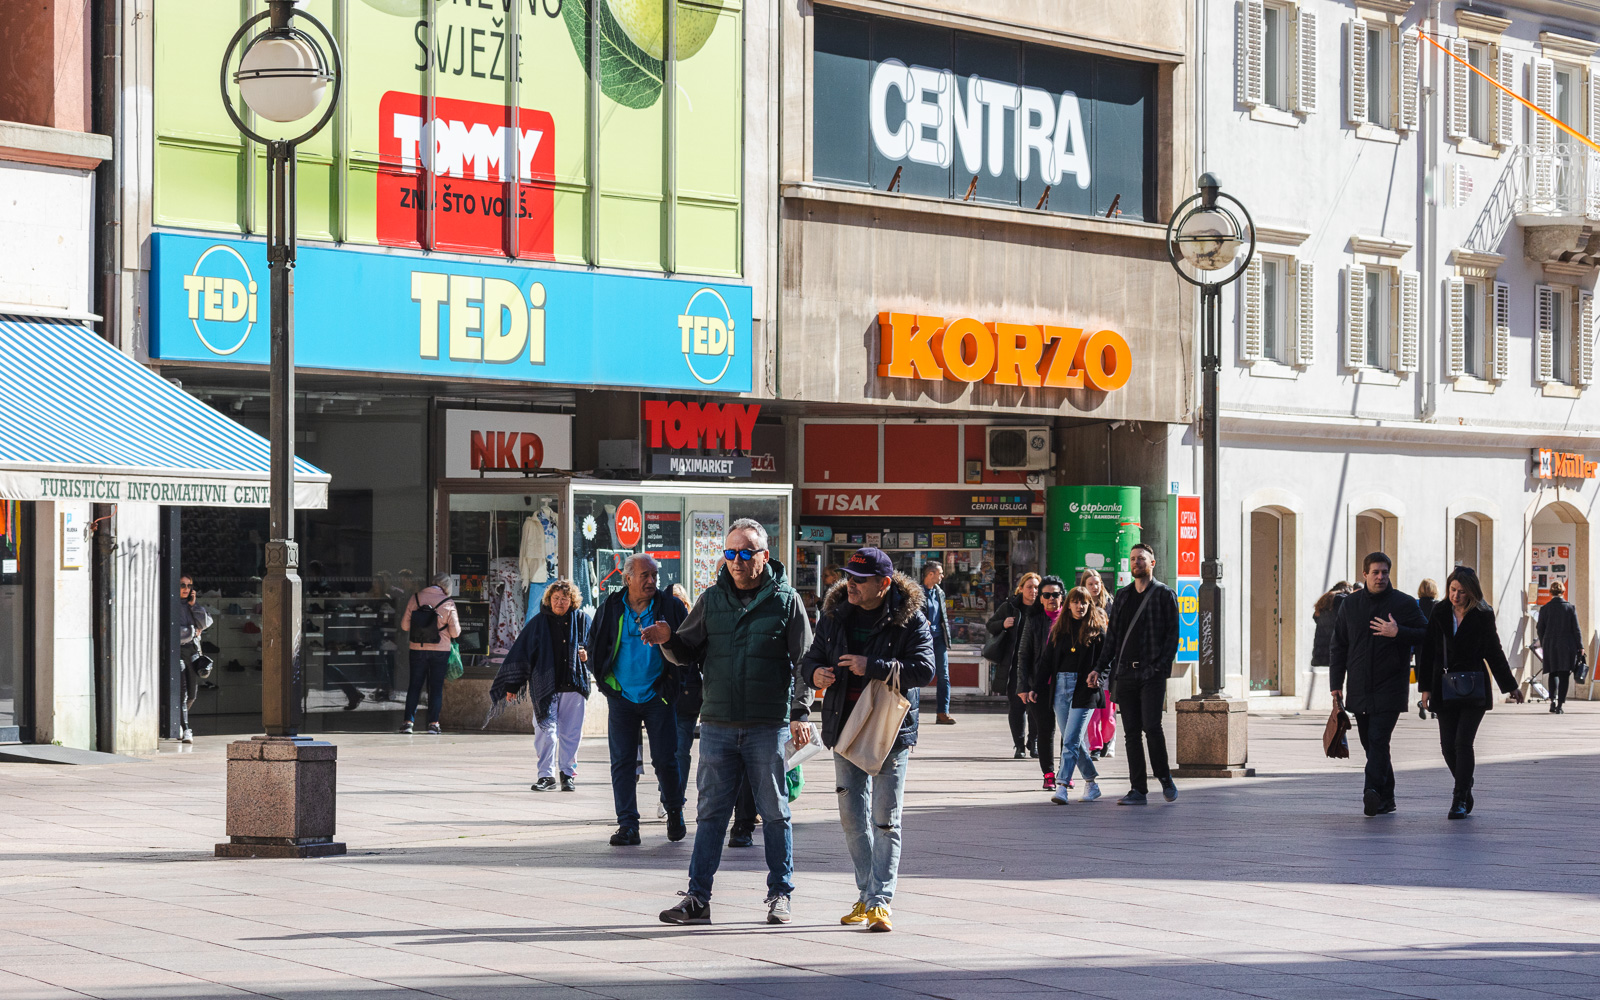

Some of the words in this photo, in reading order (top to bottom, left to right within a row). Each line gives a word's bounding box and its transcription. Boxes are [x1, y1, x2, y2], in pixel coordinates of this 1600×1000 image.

[870, 58, 1091, 189] CENTRA
[394, 113, 544, 184] TOMMY
[442, 183, 476, 214] ŠTO
[183, 274, 258, 324] TEDi
[411, 270, 547, 366] TEDi
[678, 314, 735, 356] TEDi
[878, 311, 1133, 392] KORZO
[641, 400, 762, 450] TOMMY
[470, 430, 544, 471] NKD
[670, 457, 734, 474] MAXIMARKET
[1554, 451, 1598, 478] Müller
[40, 474, 120, 501] TURISTIČKI
[127, 481, 227, 503] INFORMATIVNI
[233, 485, 270, 504] CENT
[815, 494, 881, 511] TISAK
[971, 503, 998, 511] CENTAR
[1181, 511, 1197, 524] OPTIKA
[618, 516, 639, 533] -20%
[1180, 526, 1197, 539] KORZO
[1179, 637, 1186, 651] 2.
[1187, 636, 1199, 651] kat
